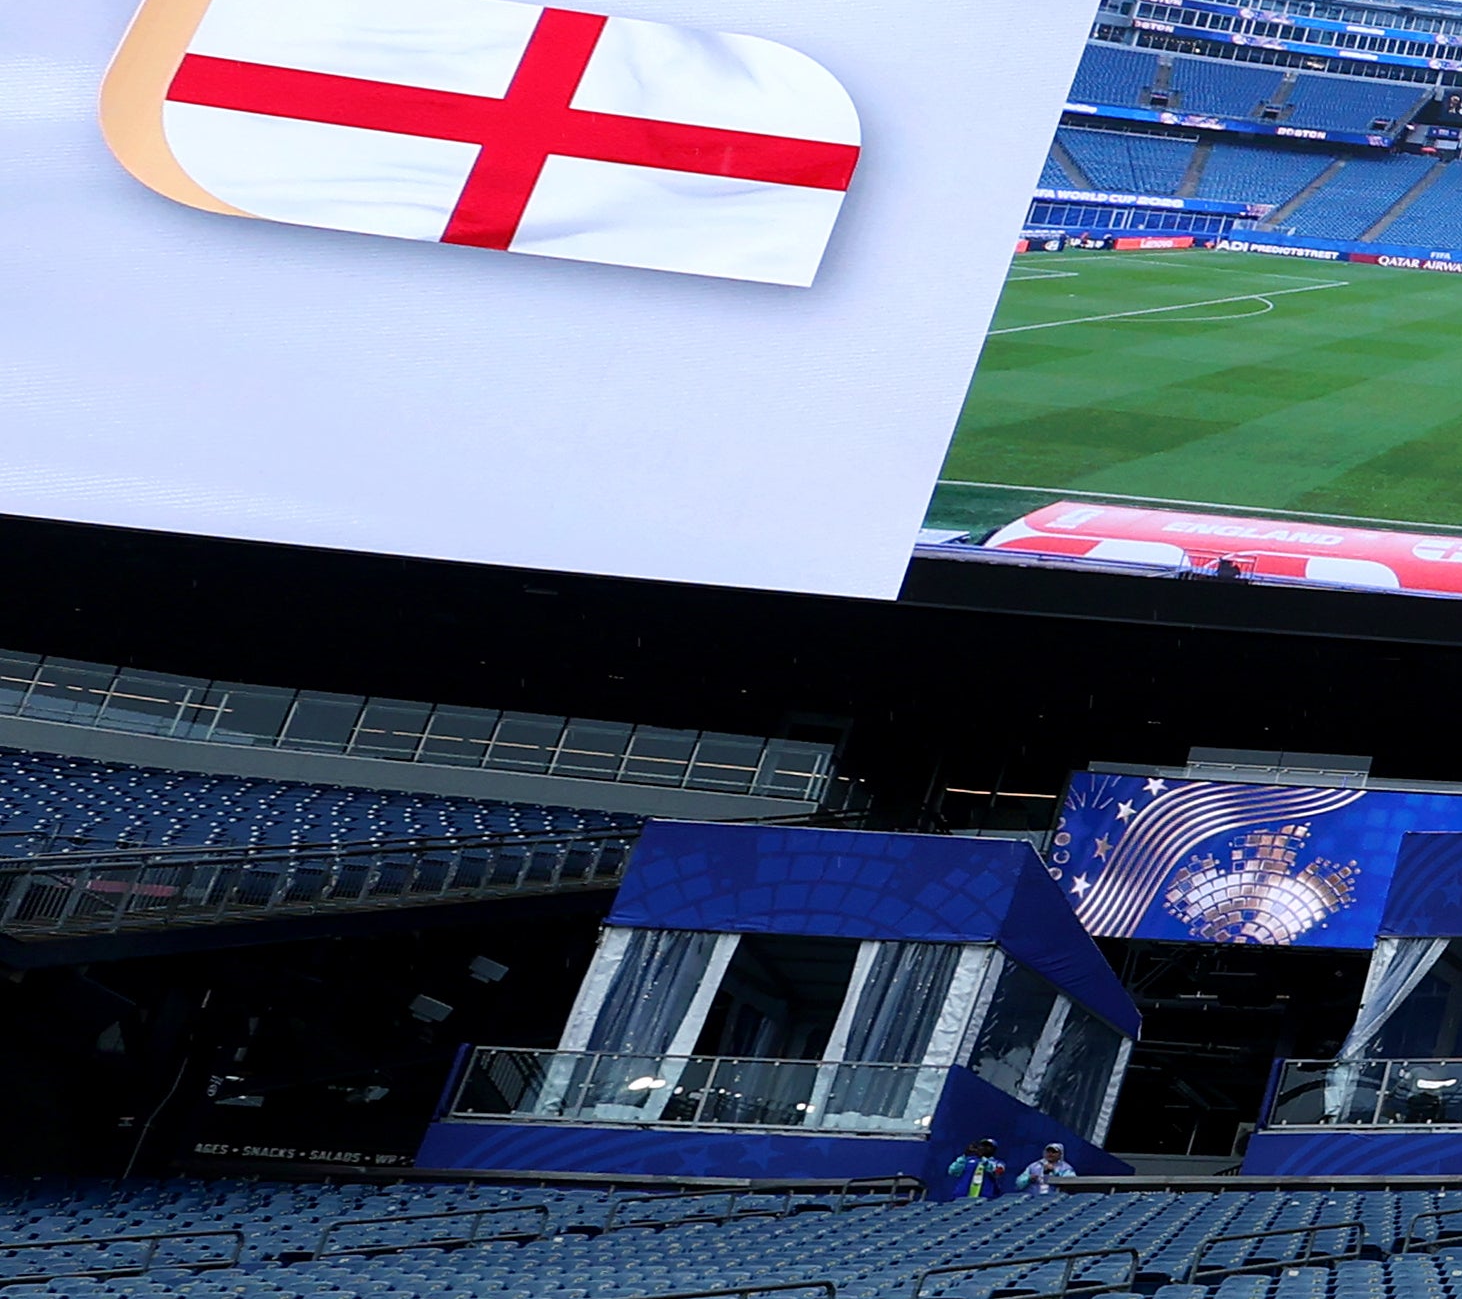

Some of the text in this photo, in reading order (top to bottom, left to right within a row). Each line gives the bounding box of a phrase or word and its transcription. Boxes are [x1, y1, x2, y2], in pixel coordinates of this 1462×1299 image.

[1058, 190, 1106, 203] WORLD
[1109, 193, 1135, 204] CUP
[1378, 255, 1419, 269] QATAR
[1430, 251, 1451, 260] FIFA
[1163, 522, 1343, 546] ENGLAND
